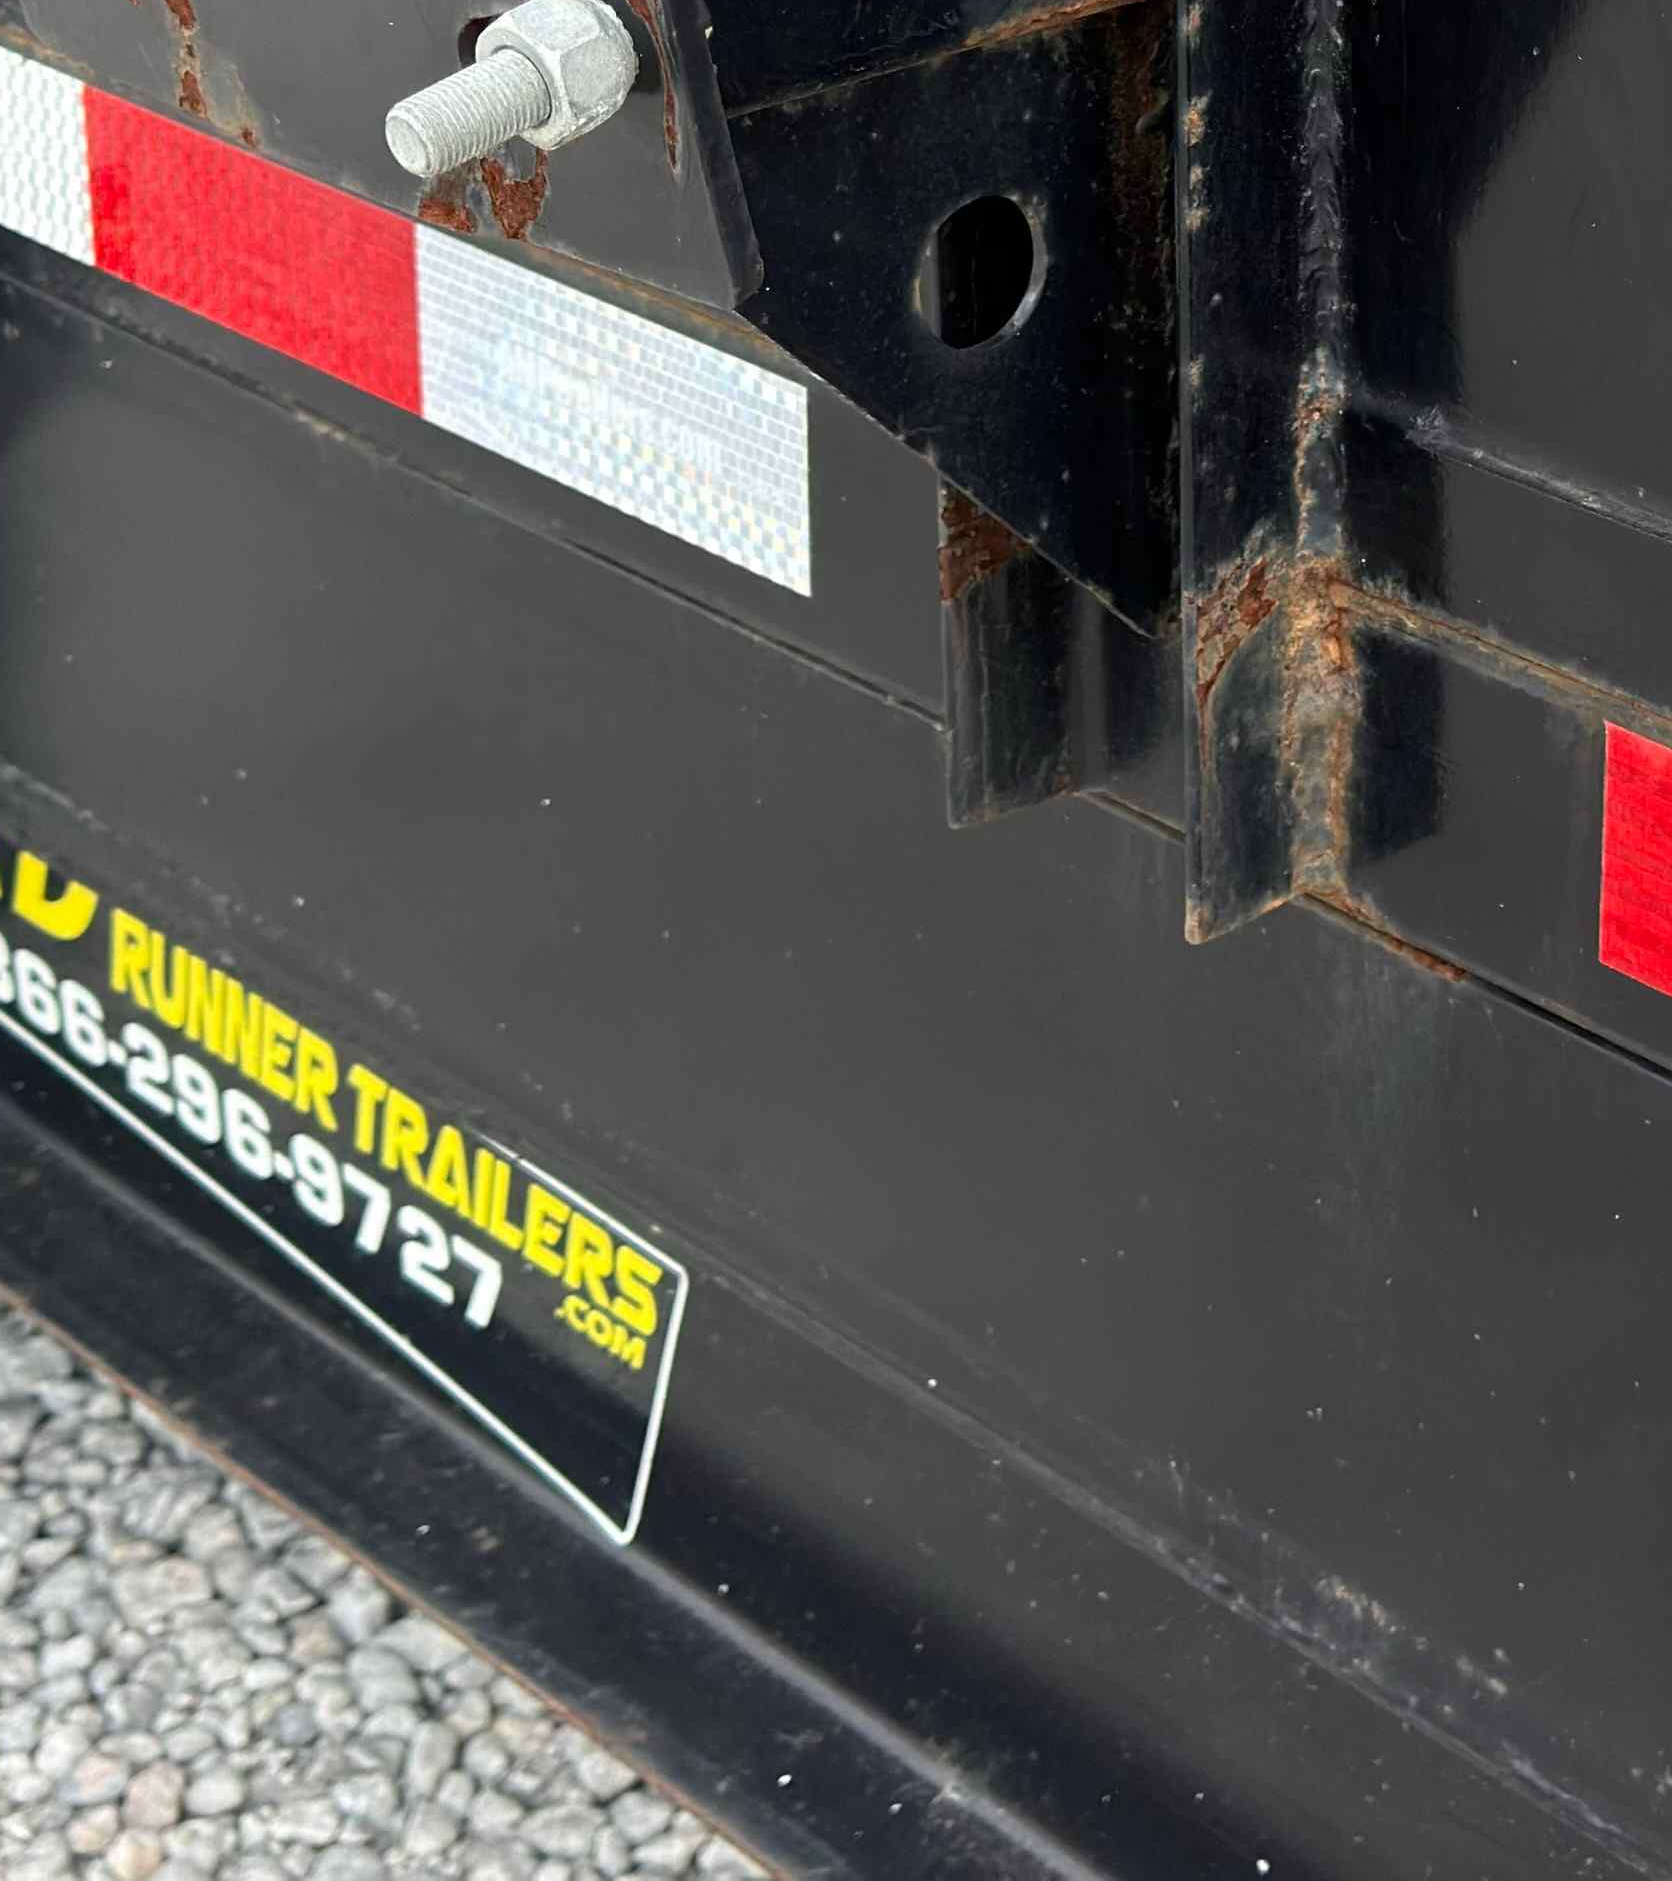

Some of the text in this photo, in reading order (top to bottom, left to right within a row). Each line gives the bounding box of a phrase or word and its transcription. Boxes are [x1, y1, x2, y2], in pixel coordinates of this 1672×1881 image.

[109, 909, 340, 1133] RUNNER
[346, 1064, 663, 1336] TRAILERS
[553, 1294, 648, 1370] .COM
